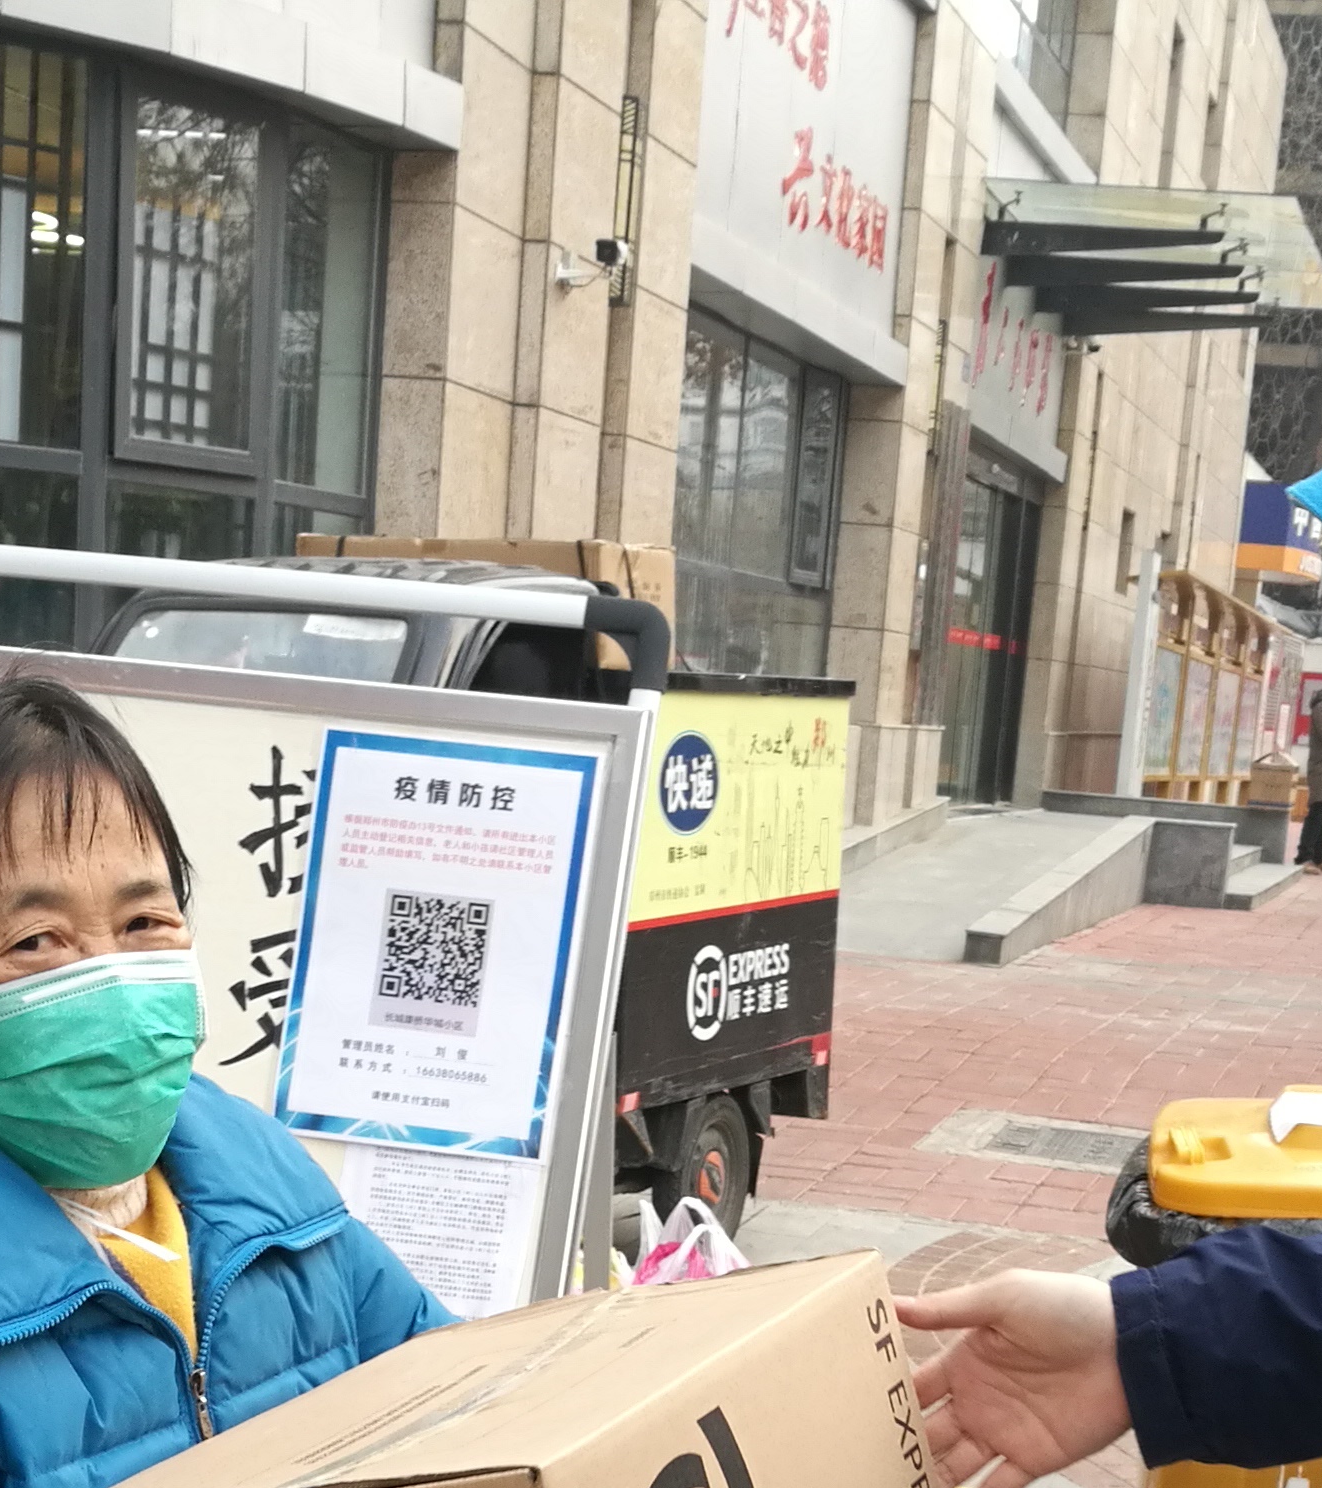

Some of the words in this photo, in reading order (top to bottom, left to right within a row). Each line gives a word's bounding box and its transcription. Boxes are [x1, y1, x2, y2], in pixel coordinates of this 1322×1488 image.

[394, 775, 517, 812] 疫情防控
[664, 752, 715, 815] 快递
[728, 942, 791, 986] EXPRESS
[727, 978, 789, 1022] 顺丰速运
[867, 1298, 897, 1363] SF
